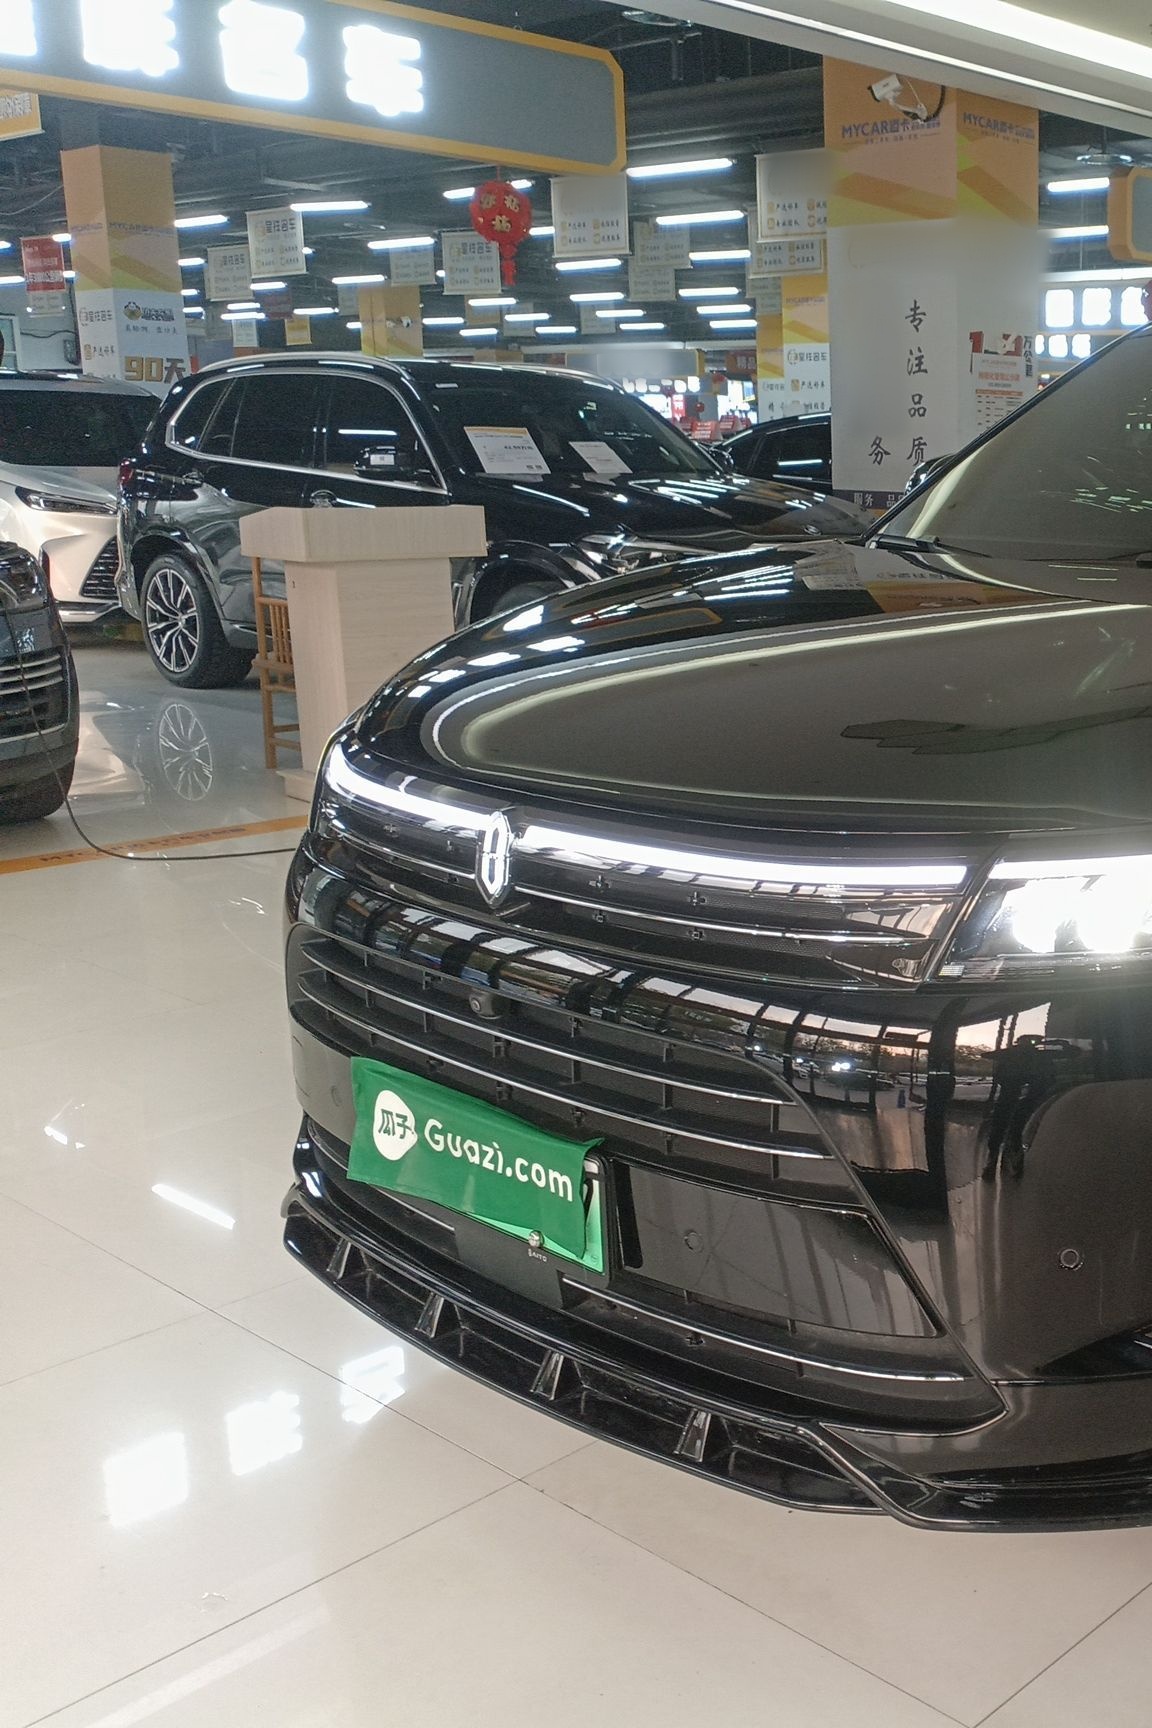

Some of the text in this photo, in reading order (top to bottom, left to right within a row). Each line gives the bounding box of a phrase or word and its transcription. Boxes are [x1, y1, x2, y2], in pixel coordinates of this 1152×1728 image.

[124, 355, 186, 384] 90天
[904, 299, 929, 468] 专注品质
[868, 435, 892, 467] 务
[379, 1109, 413, 1139] 瓜子
